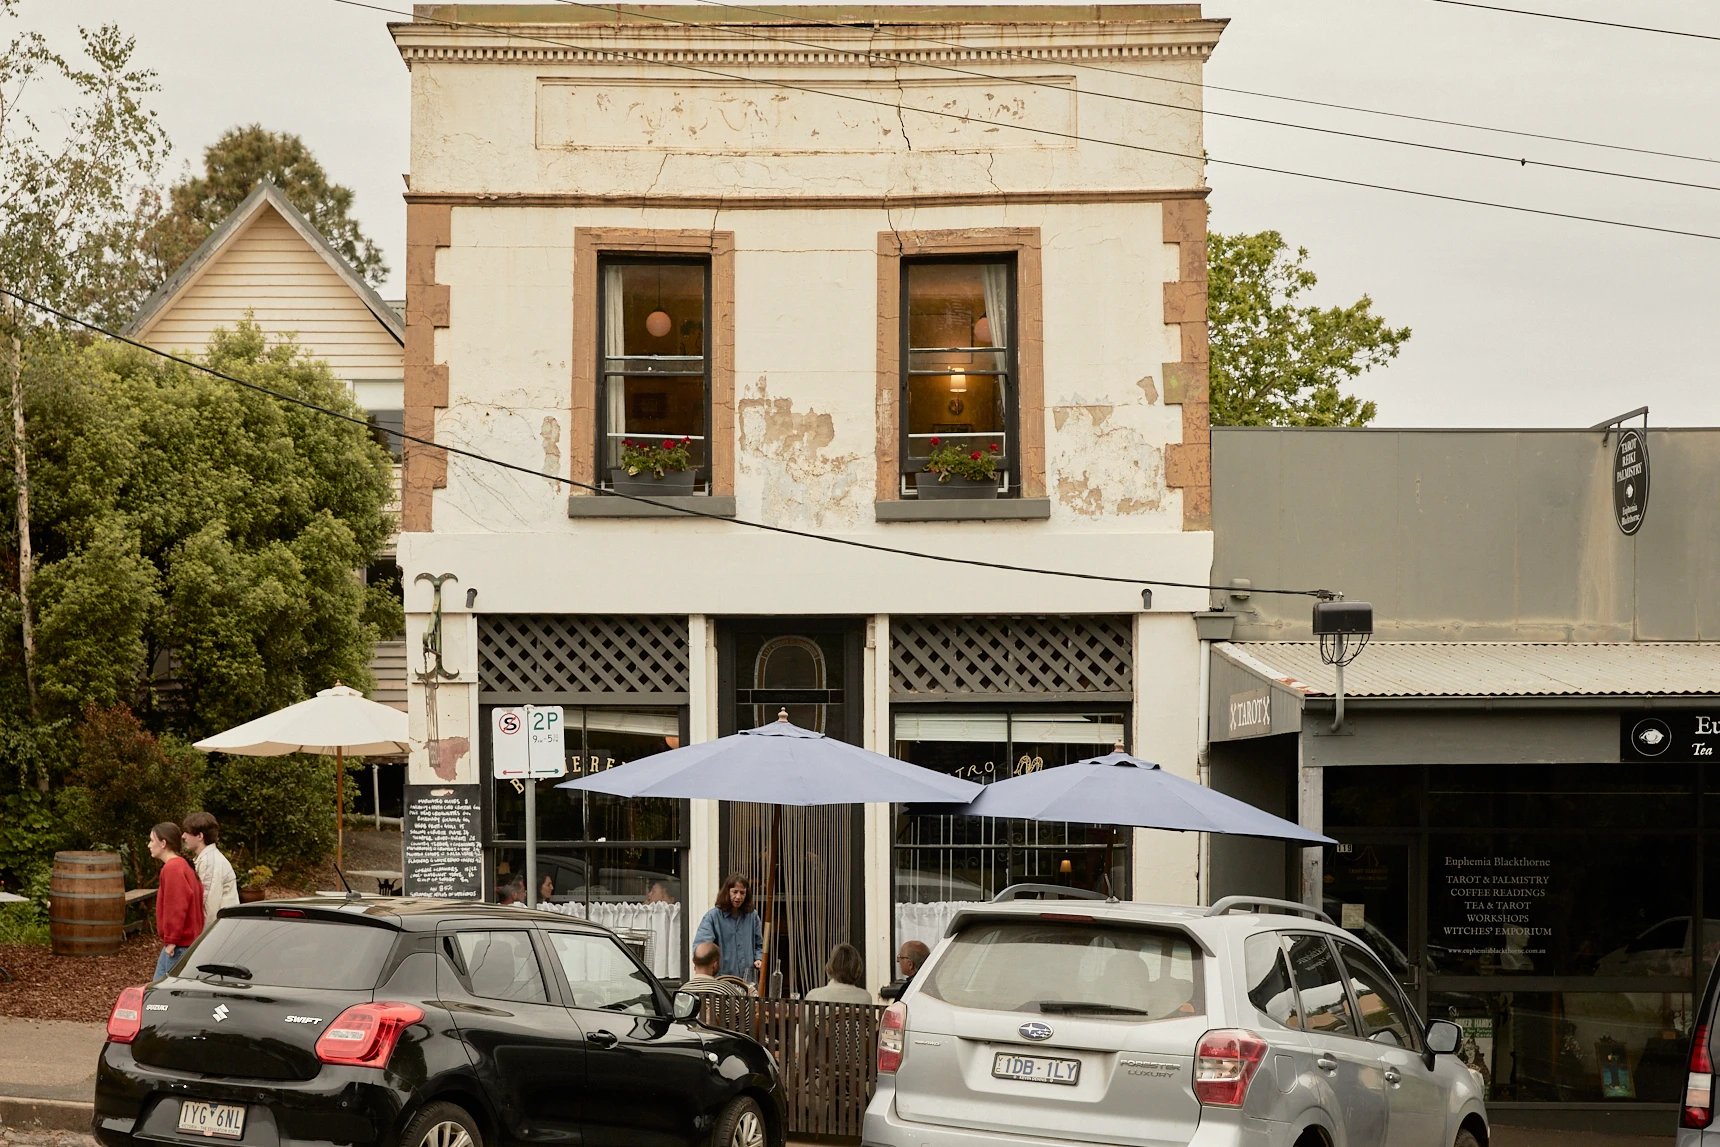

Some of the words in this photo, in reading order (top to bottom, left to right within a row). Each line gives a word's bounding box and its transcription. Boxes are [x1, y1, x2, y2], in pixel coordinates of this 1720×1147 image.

[1621, 438, 1638, 454] TAROT
[1622, 451, 1636, 467] REIKI
[1616, 462, 1643, 482] PALMISTRY
[1237, 698, 1263, 727] TAROT
[533, 712, 559, 730] 2P
[1691, 742, 1713, 756] Tea
[1444, 856, 1491, 869] Euphemia
[1493, 856, 1551, 867] Blackthorne
[1446, 875, 1482, 884] TAROT
[1482, 875, 1490, 884] &
[1492, 875, 1550, 884] PALMISTRY
[1450, 888, 1490, 897] COFFEE
[1493, 888, 1546, 897] READINGS
[1464, 901, 1485, 910] TEA
[1486, 901, 1494, 910] &
[1495, 901, 1531, 910] TAROT
[1466, 914, 1529, 923] WORKSHOPS
[1495, 927, 1552, 936] EMPORIUM
[284, 1014, 323, 1025] SWIFT
[1120, 1059, 1181, 1071] FORESTER
[1128, 1068, 1174, 1078] LUXURY
